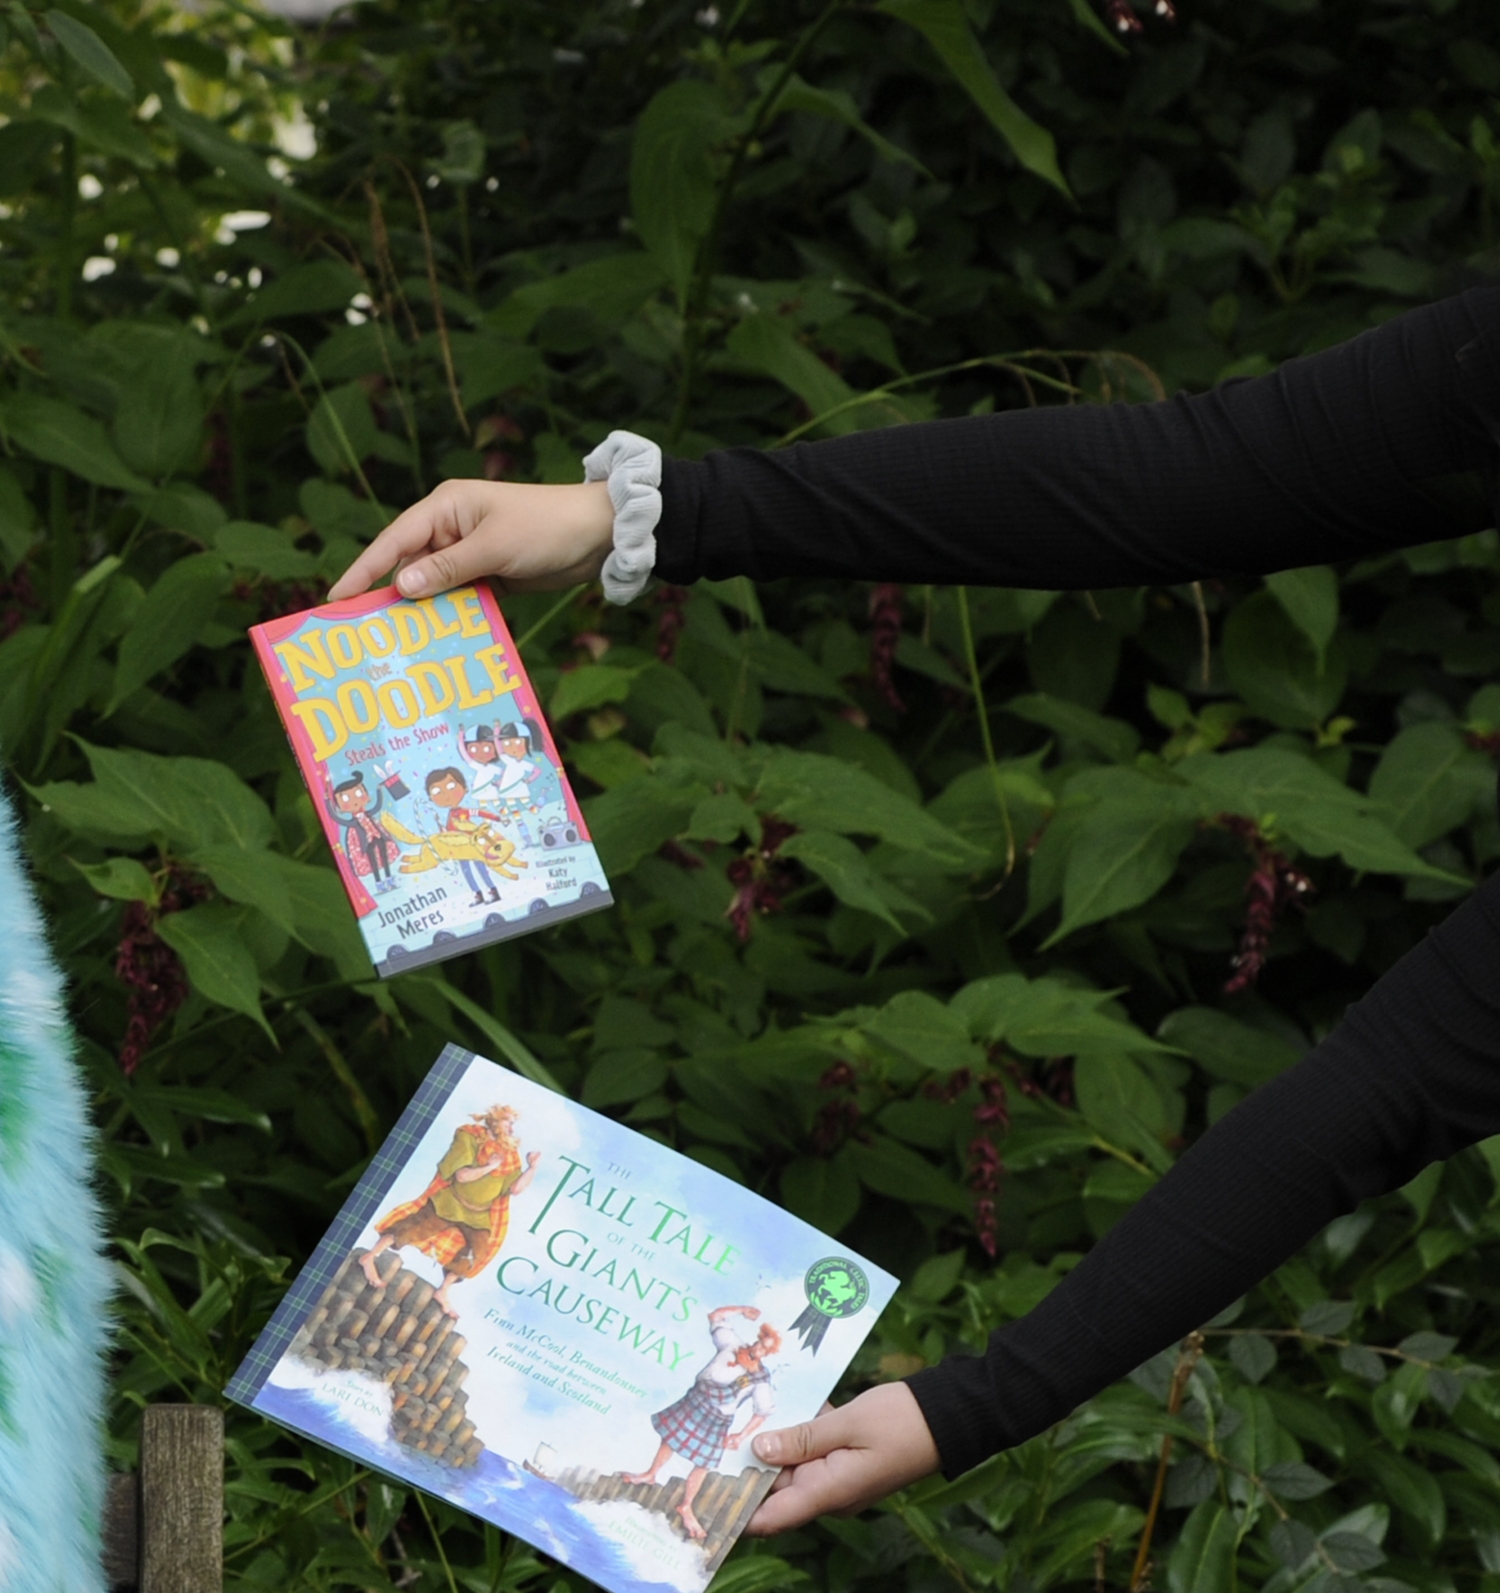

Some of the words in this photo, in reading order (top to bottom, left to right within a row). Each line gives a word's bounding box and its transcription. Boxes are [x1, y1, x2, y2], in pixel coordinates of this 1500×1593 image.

[274, 586, 492, 692] NOODLE
[367, 662, 392, 681] the
[289, 642, 522, 763] DOODLE
[344, 741, 386, 766] Steals
[387, 735, 411, 751] the
[413, 721, 449, 745] Show
[378, 887, 447, 928] Jonathan
[396, 910, 444, 939] Meres
[606, 1162, 633, 1180] THE
[528, 1155, 638, 1235] TALL
[647, 1200, 742, 1276] TALE
[607, 1231, 627, 1246] OF
[631, 1243, 656, 1262] THE
[546, 1229, 698, 1322] GIANT'S
[496, 1256, 695, 1372] CAUSEWAY
[483, 1308, 515, 1331] Finn
[515, 1324, 567, 1359] McCool,
[569, 1350, 648, 1398] Benandonner
[506, 1341, 528, 1354] and
[527, 1348, 543, 1362] the
[543, 1358, 567, 1374] road
[567, 1369, 608, 1395] between
[322, 1382, 351, 1401] LARI
[354, 1396, 384, 1416] DON
[487, 1345, 534, 1376] Ireland
[532, 1372, 559, 1388] and
[558, 1380, 612, 1415] Scotland
[608, 1520, 650, 1552] EMILIE
[653, 1547, 680, 1570] GILL
